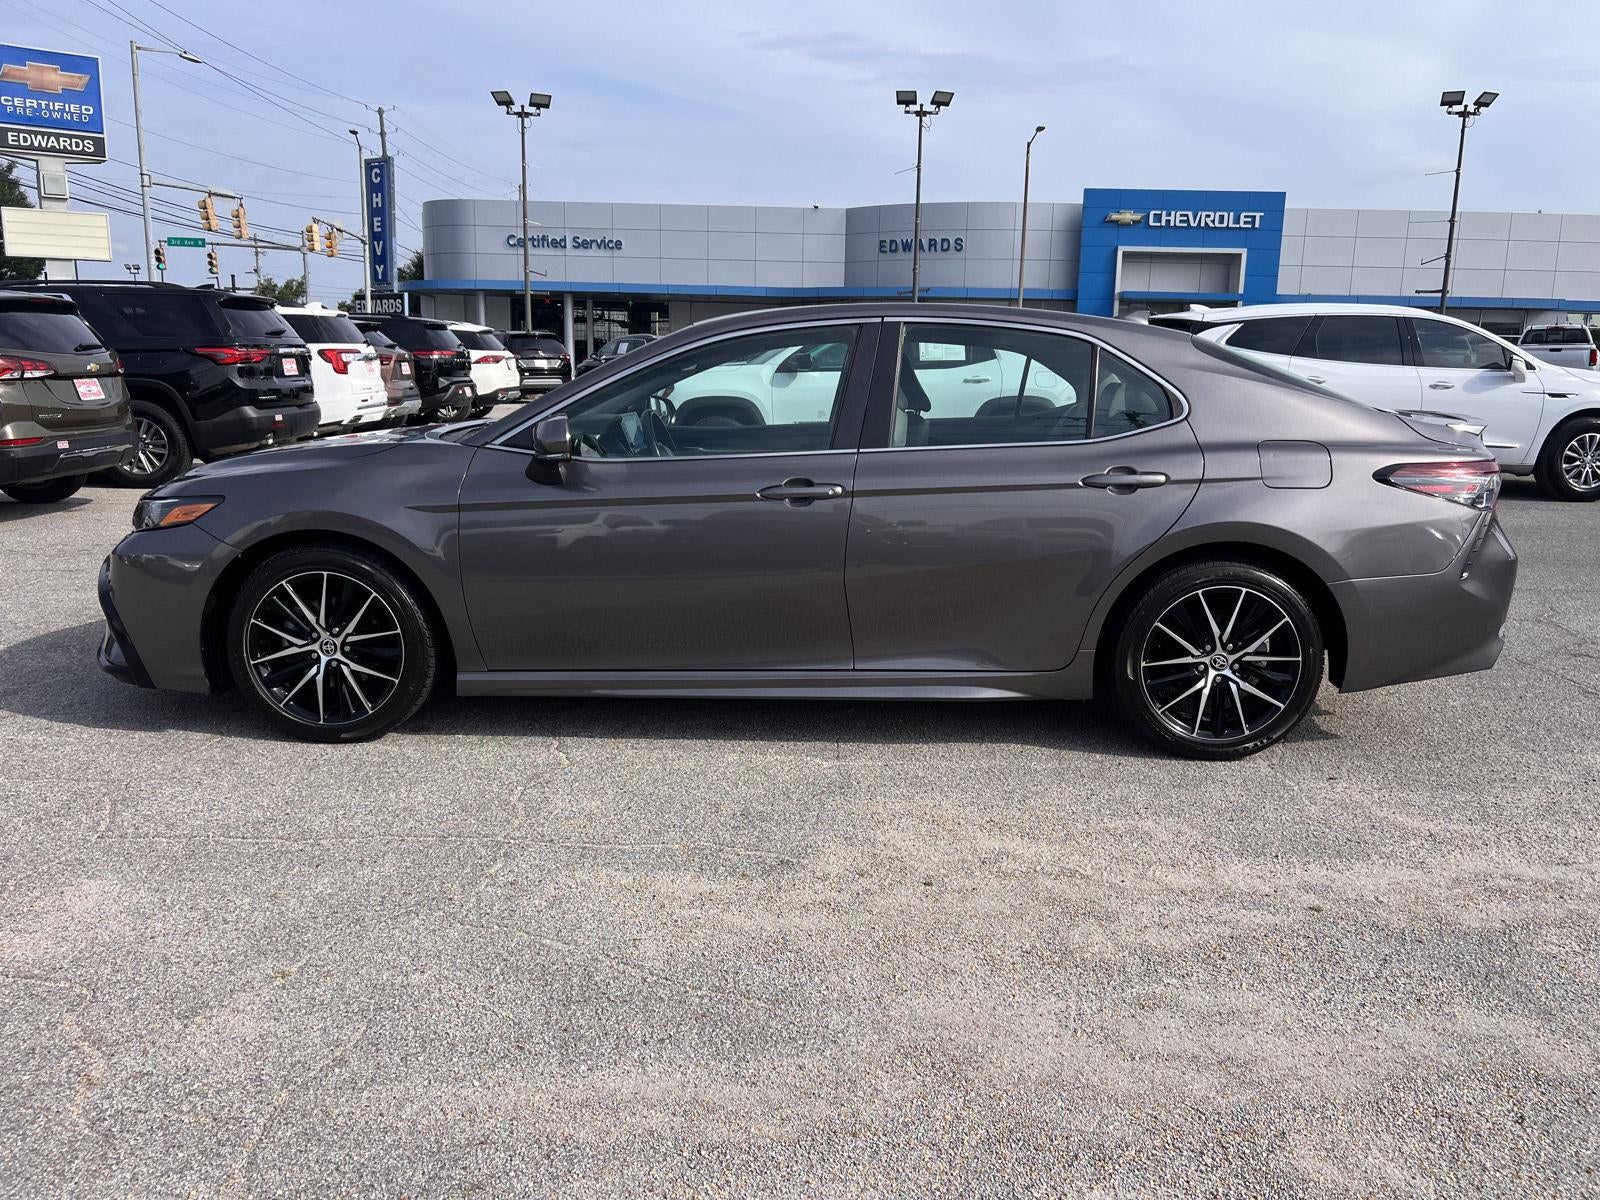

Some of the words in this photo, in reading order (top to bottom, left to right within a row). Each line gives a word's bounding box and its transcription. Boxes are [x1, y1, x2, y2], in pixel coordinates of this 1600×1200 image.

[1, 96, 94, 114] CERTIFIED
[7, 106, 90, 122] PRE-OWNED
[7, 131, 95, 153] EDWARDS
[371, 168, 385, 280] CHEVY
[1148, 210, 1265, 229] CHEVROLET
[572, 235, 623, 250] Service
